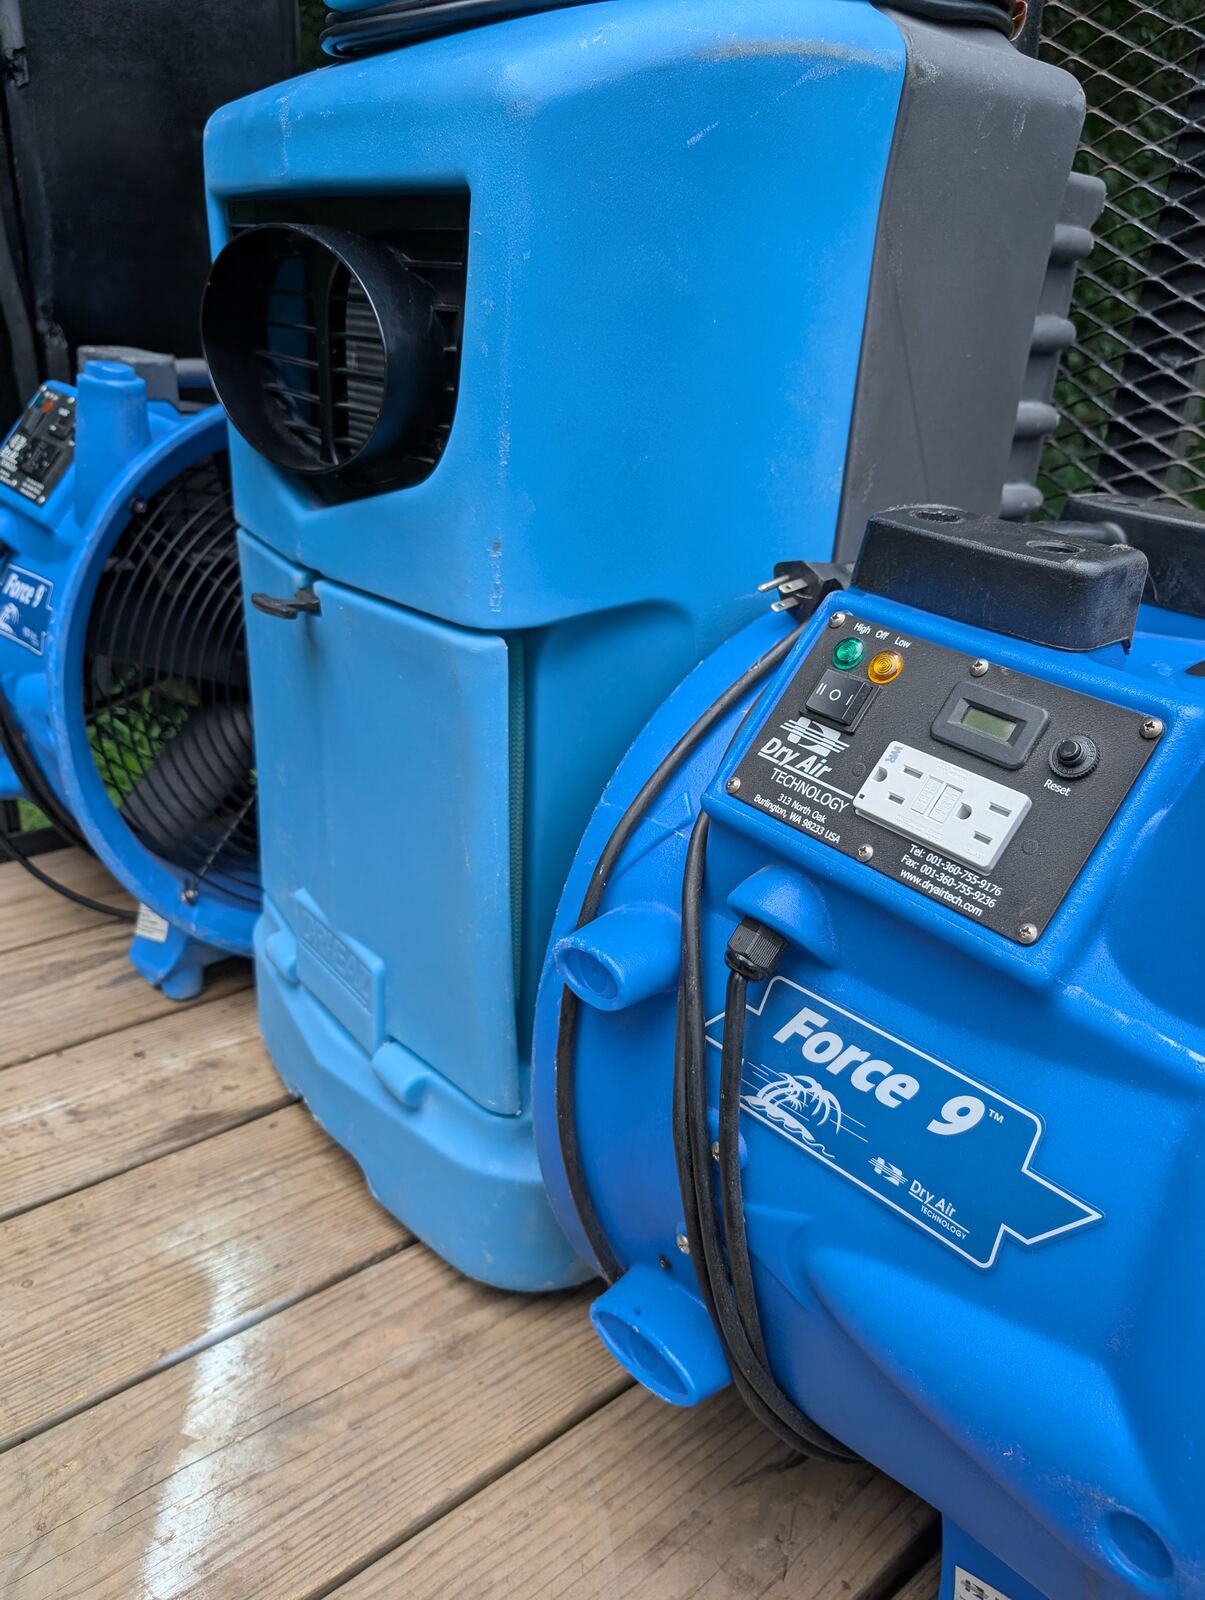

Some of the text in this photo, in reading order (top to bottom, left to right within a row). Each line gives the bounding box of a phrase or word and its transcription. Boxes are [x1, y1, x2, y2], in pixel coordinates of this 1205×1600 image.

[854, 622, 912, 649] High Off Low
[760, 737, 833, 778] Dry Air
[771, 767, 850, 813] TECHNOLOGY
[777, 793, 828, 824] 313 North Oak
[1043, 778, 1072, 797] Reset
[753, 794, 841, 844] Burlington, WA 98233 USA
[900, 854, 997, 909] Fax: 001-360-755-9236
[909, 844, 926, 858] Tel:
[925, 853, 1003, 896] 001-360-755-9176
[900, 869, 983, 917] www.dryairtech.com
[772, 1007, 920, 1109] Force
[926, 1095, 985, 1136] 9
[909, 1179, 956, 1217] Dry Air
[921, 1205, 967, 1240] TECHNOLOGY
